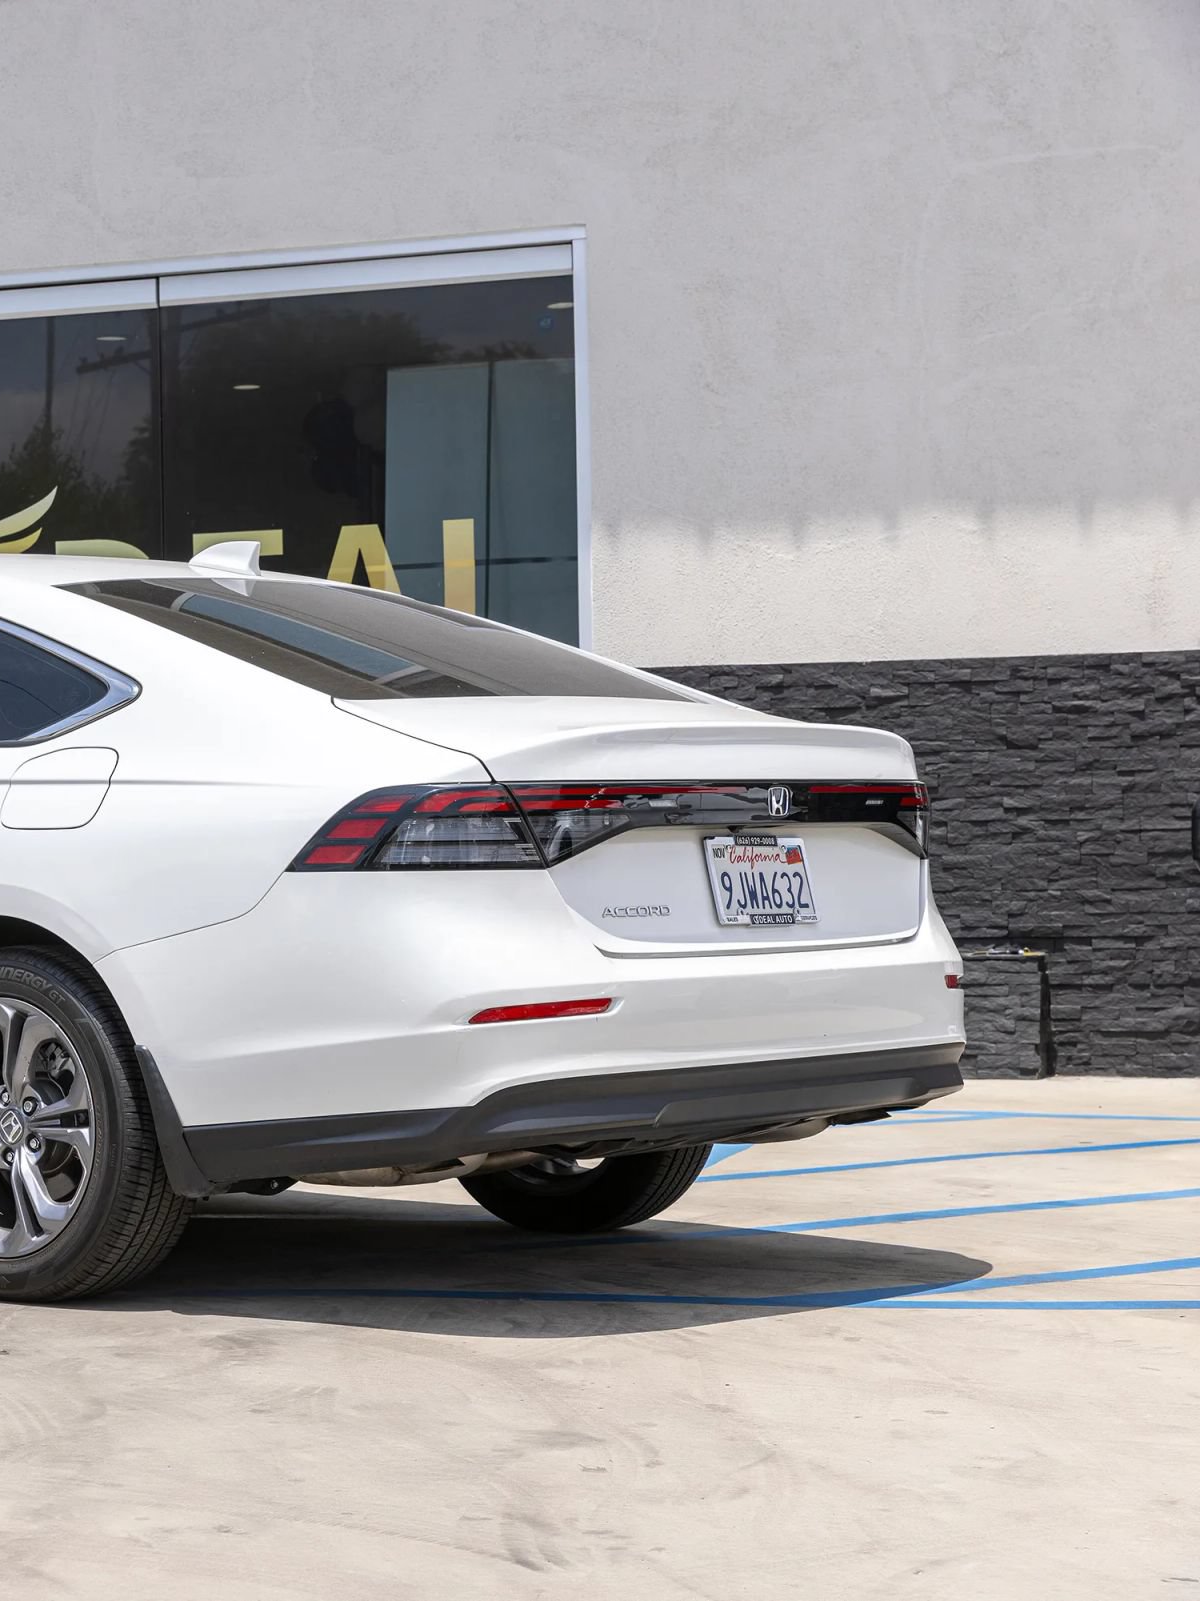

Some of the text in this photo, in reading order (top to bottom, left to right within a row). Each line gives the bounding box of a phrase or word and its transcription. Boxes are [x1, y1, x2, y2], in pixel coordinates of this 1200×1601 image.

[712, 847, 726, 859] NOV
[729, 845, 785, 870] California
[720, 871, 810, 910] 9JWA632
[601, 905, 672, 919] ACCORD
[776, 915, 793, 924] AUTO
[48, 989, 66, 1006] GT
